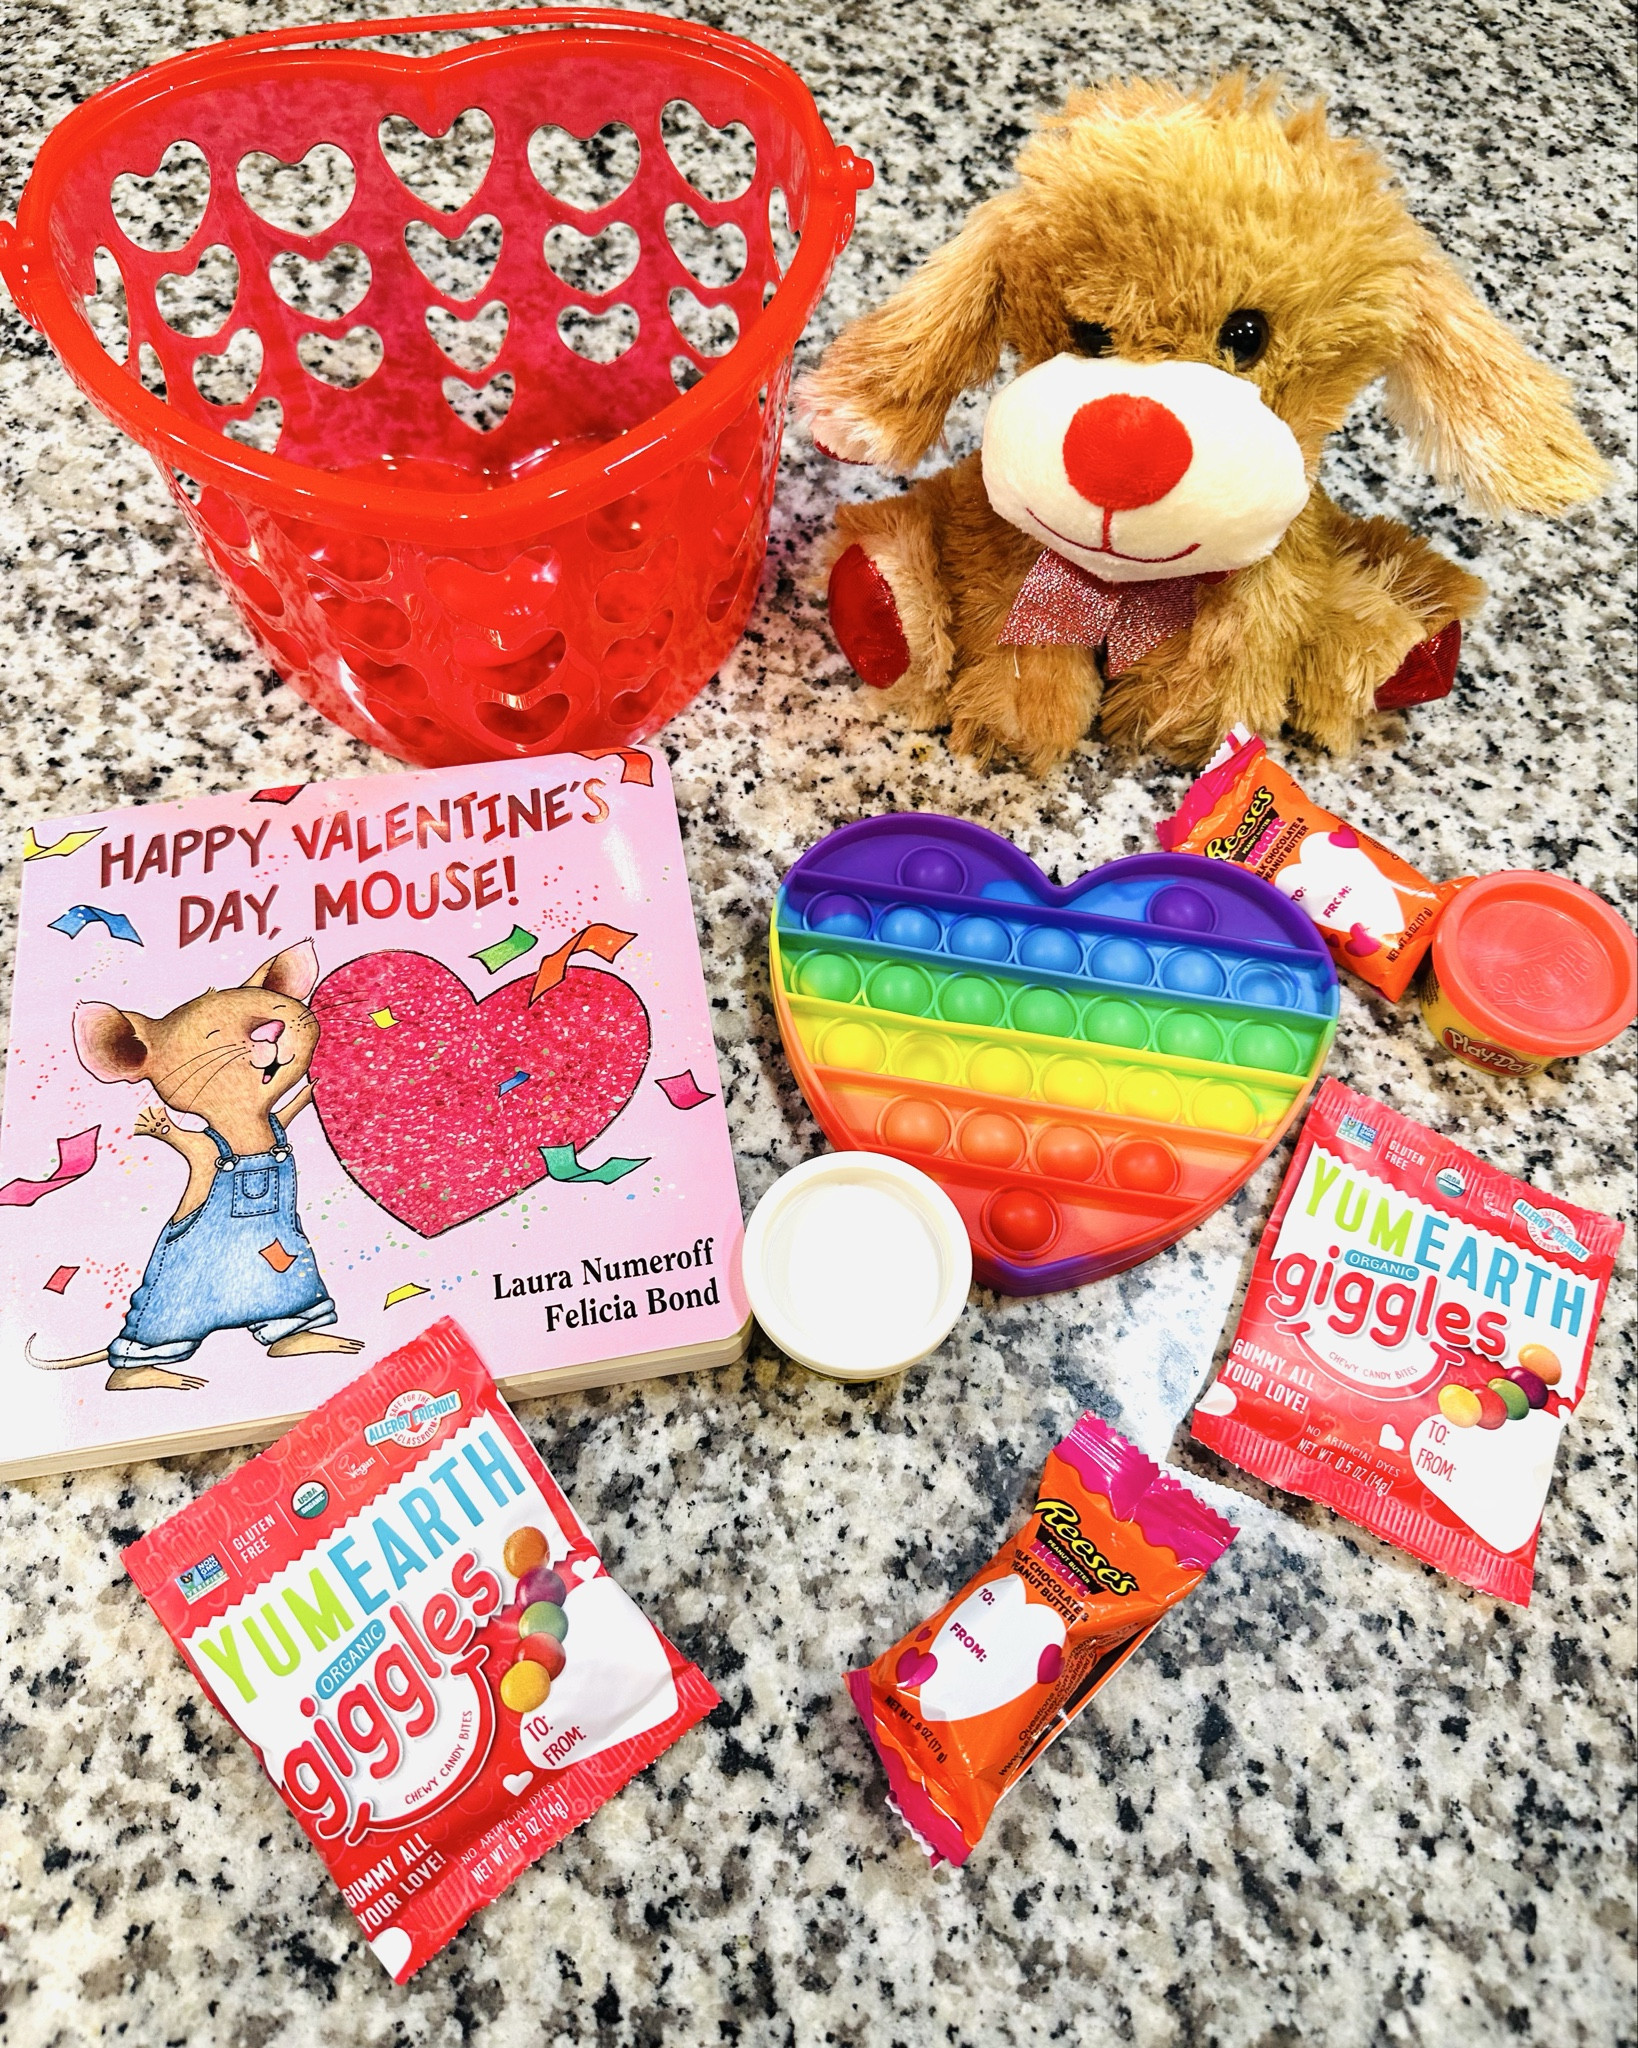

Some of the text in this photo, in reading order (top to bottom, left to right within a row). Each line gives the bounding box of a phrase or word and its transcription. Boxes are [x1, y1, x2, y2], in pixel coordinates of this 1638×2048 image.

[100, 777, 610, 889] HAPPY VALENTINE'S
[1205, 786, 1274, 860] Reese's
[1255, 864, 1268, 878] ILK
[1265, 821, 1301, 865] CHOCOLATE
[1263, 825, 1309, 882] PEANUT BUTTER
[179, 855, 519, 948] DAY, MOUSE!
[1386, 948, 1400, 962] NET
[1448, 1028, 1535, 1075] Play-Doh
[1385, 1151, 1409, 1171] FREE
[1389, 1140, 1426, 1166] GLUTEN
[1305, 1155, 1587, 1338] YUMEARTH
[1515, 1202, 1589, 1260] ALLERGY FRIENDLY
[493, 1237, 714, 1300] Laura Numeroff
[1350, 1252, 1415, 1281] ORGANIC
[545, 1277, 720, 1332] Felicia Bond
[1268, 1245, 1508, 1357] giggles
[1223, 1358, 1310, 1414] YOUR LOVE!
[1232, 1338, 1316, 1392] GUMMY ALL
[1329, 1351, 1418, 1381] CHEWY CANDY BITES
[369, 1394, 457, 1443] ALLERGY FRIENDLY
[403, 1394, 415, 1403] FOR
[418, 1394, 430, 1404] THE
[397, 1422, 438, 1445] CLASSROOM
[1306, 1424, 1400, 1478] NO ARTIFICIAL DYES
[1429, 1420, 1450, 1446] TO:
[1297, 1438, 1318, 1456] NET
[1318, 1445, 1334, 1466] WT.
[1335, 1456, 1351, 1473] 0.5
[1352, 1465, 1367, 1481] OZ
[1416, 1448, 1456, 1482] FROM:
[297, 1487, 318, 1505] USDA
[232, 1514, 276, 1550] GLUTEN
[240, 1536, 270, 1564] FREE
[1034, 1498, 1140, 1597] Reese's
[198, 1555, 215, 1569] NON
[199, 1430, 525, 1704] YUMEARTH
[201, 1560, 218, 1575] GMO
[1029, 1559, 1083, 1614] CHOCOLATE
[1047, 1539, 1091, 1585] PEANUT BUTTER
[979, 1588, 995, 1606] TO:
[1040, 1588, 1077, 1624] BUTTER
[318, 1623, 383, 1693] ORGANIC
[950, 1622, 987, 1662] FROM:
[284, 1553, 500, 1836] giggles
[1019, 1692, 1055, 1741] Questions
[524, 1715, 553, 1742] TO:
[542, 1726, 587, 1767] FROM:
[885, 1694, 902, 1713] NET
[900, 1708, 914, 1724] WT
[920, 1727, 933, 1742] OZ
[928, 1737, 942, 1754] (17
[405, 1710, 472, 1805] CHEWY CANDY BITES
[460, 1783, 554, 1865] NO ARTIFICIAL DYES
[342, 1832, 432, 1908] GUMMY ALL
[471, 1858, 493, 1885] NET
[489, 1844, 512, 1866] WT.
[508, 1828, 528, 1850] 0.5
[526, 1816, 543, 1836] OZ
[357, 1850, 447, 1933] YOUR LOVE!
